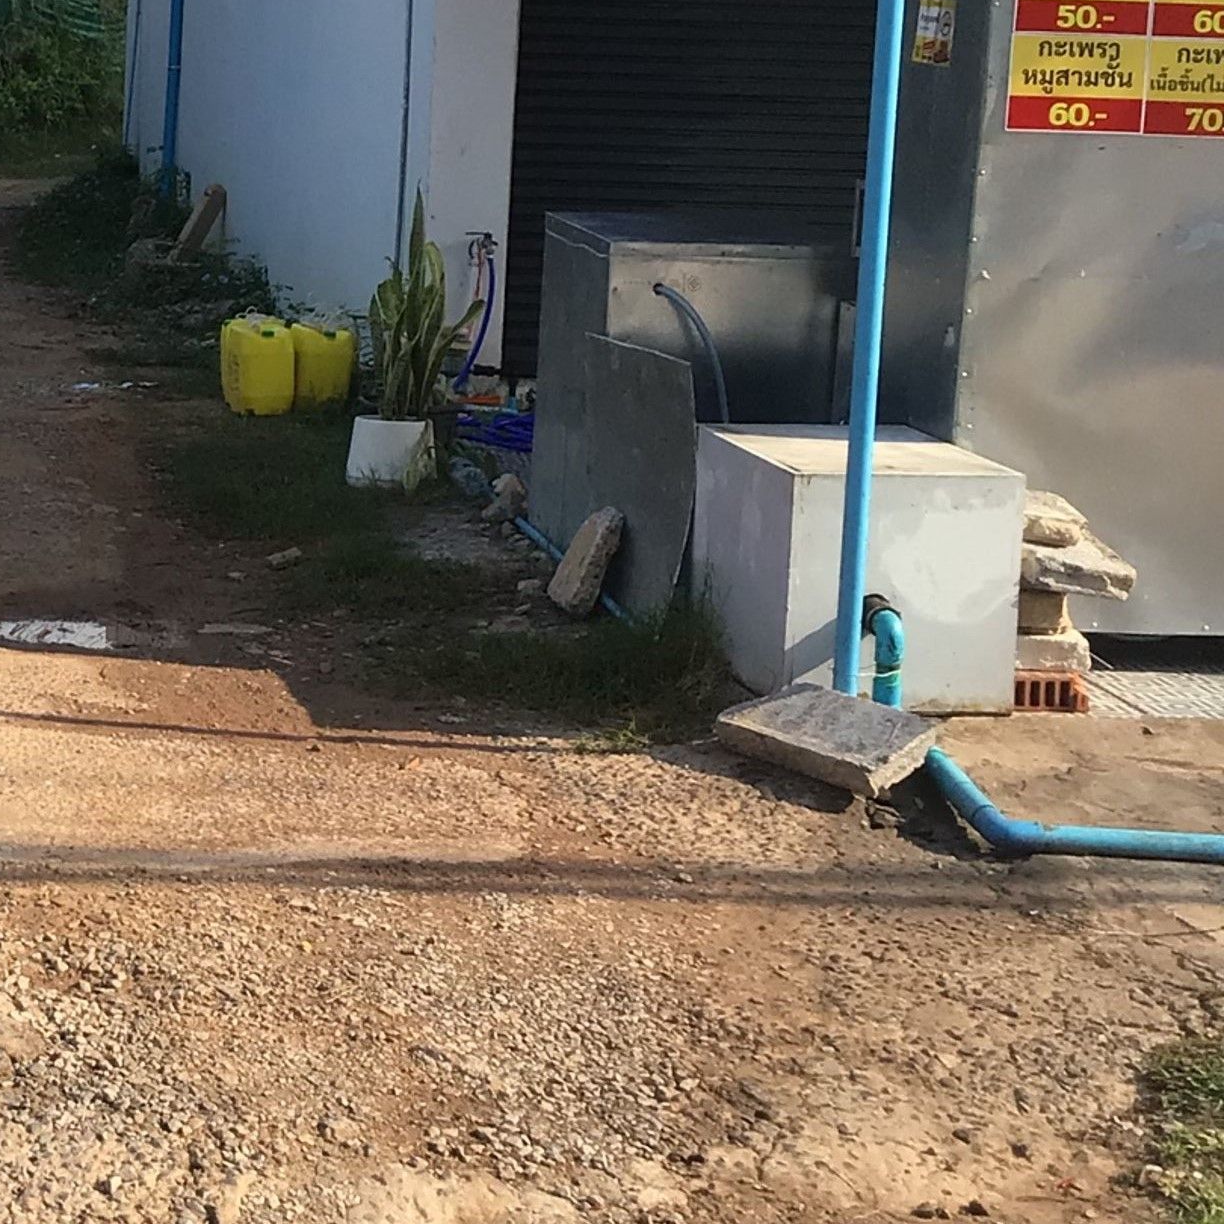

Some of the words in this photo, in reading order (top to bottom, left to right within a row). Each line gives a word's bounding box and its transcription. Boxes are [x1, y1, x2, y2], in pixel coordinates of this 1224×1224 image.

[1056, 5, 1116, 29] 50.-
[1038, 40, 1121, 59] กะเพรา
[1022, 55, 1133, 95] หมูสามชั้น
[1048, 102, 1108, 127] 60.-
